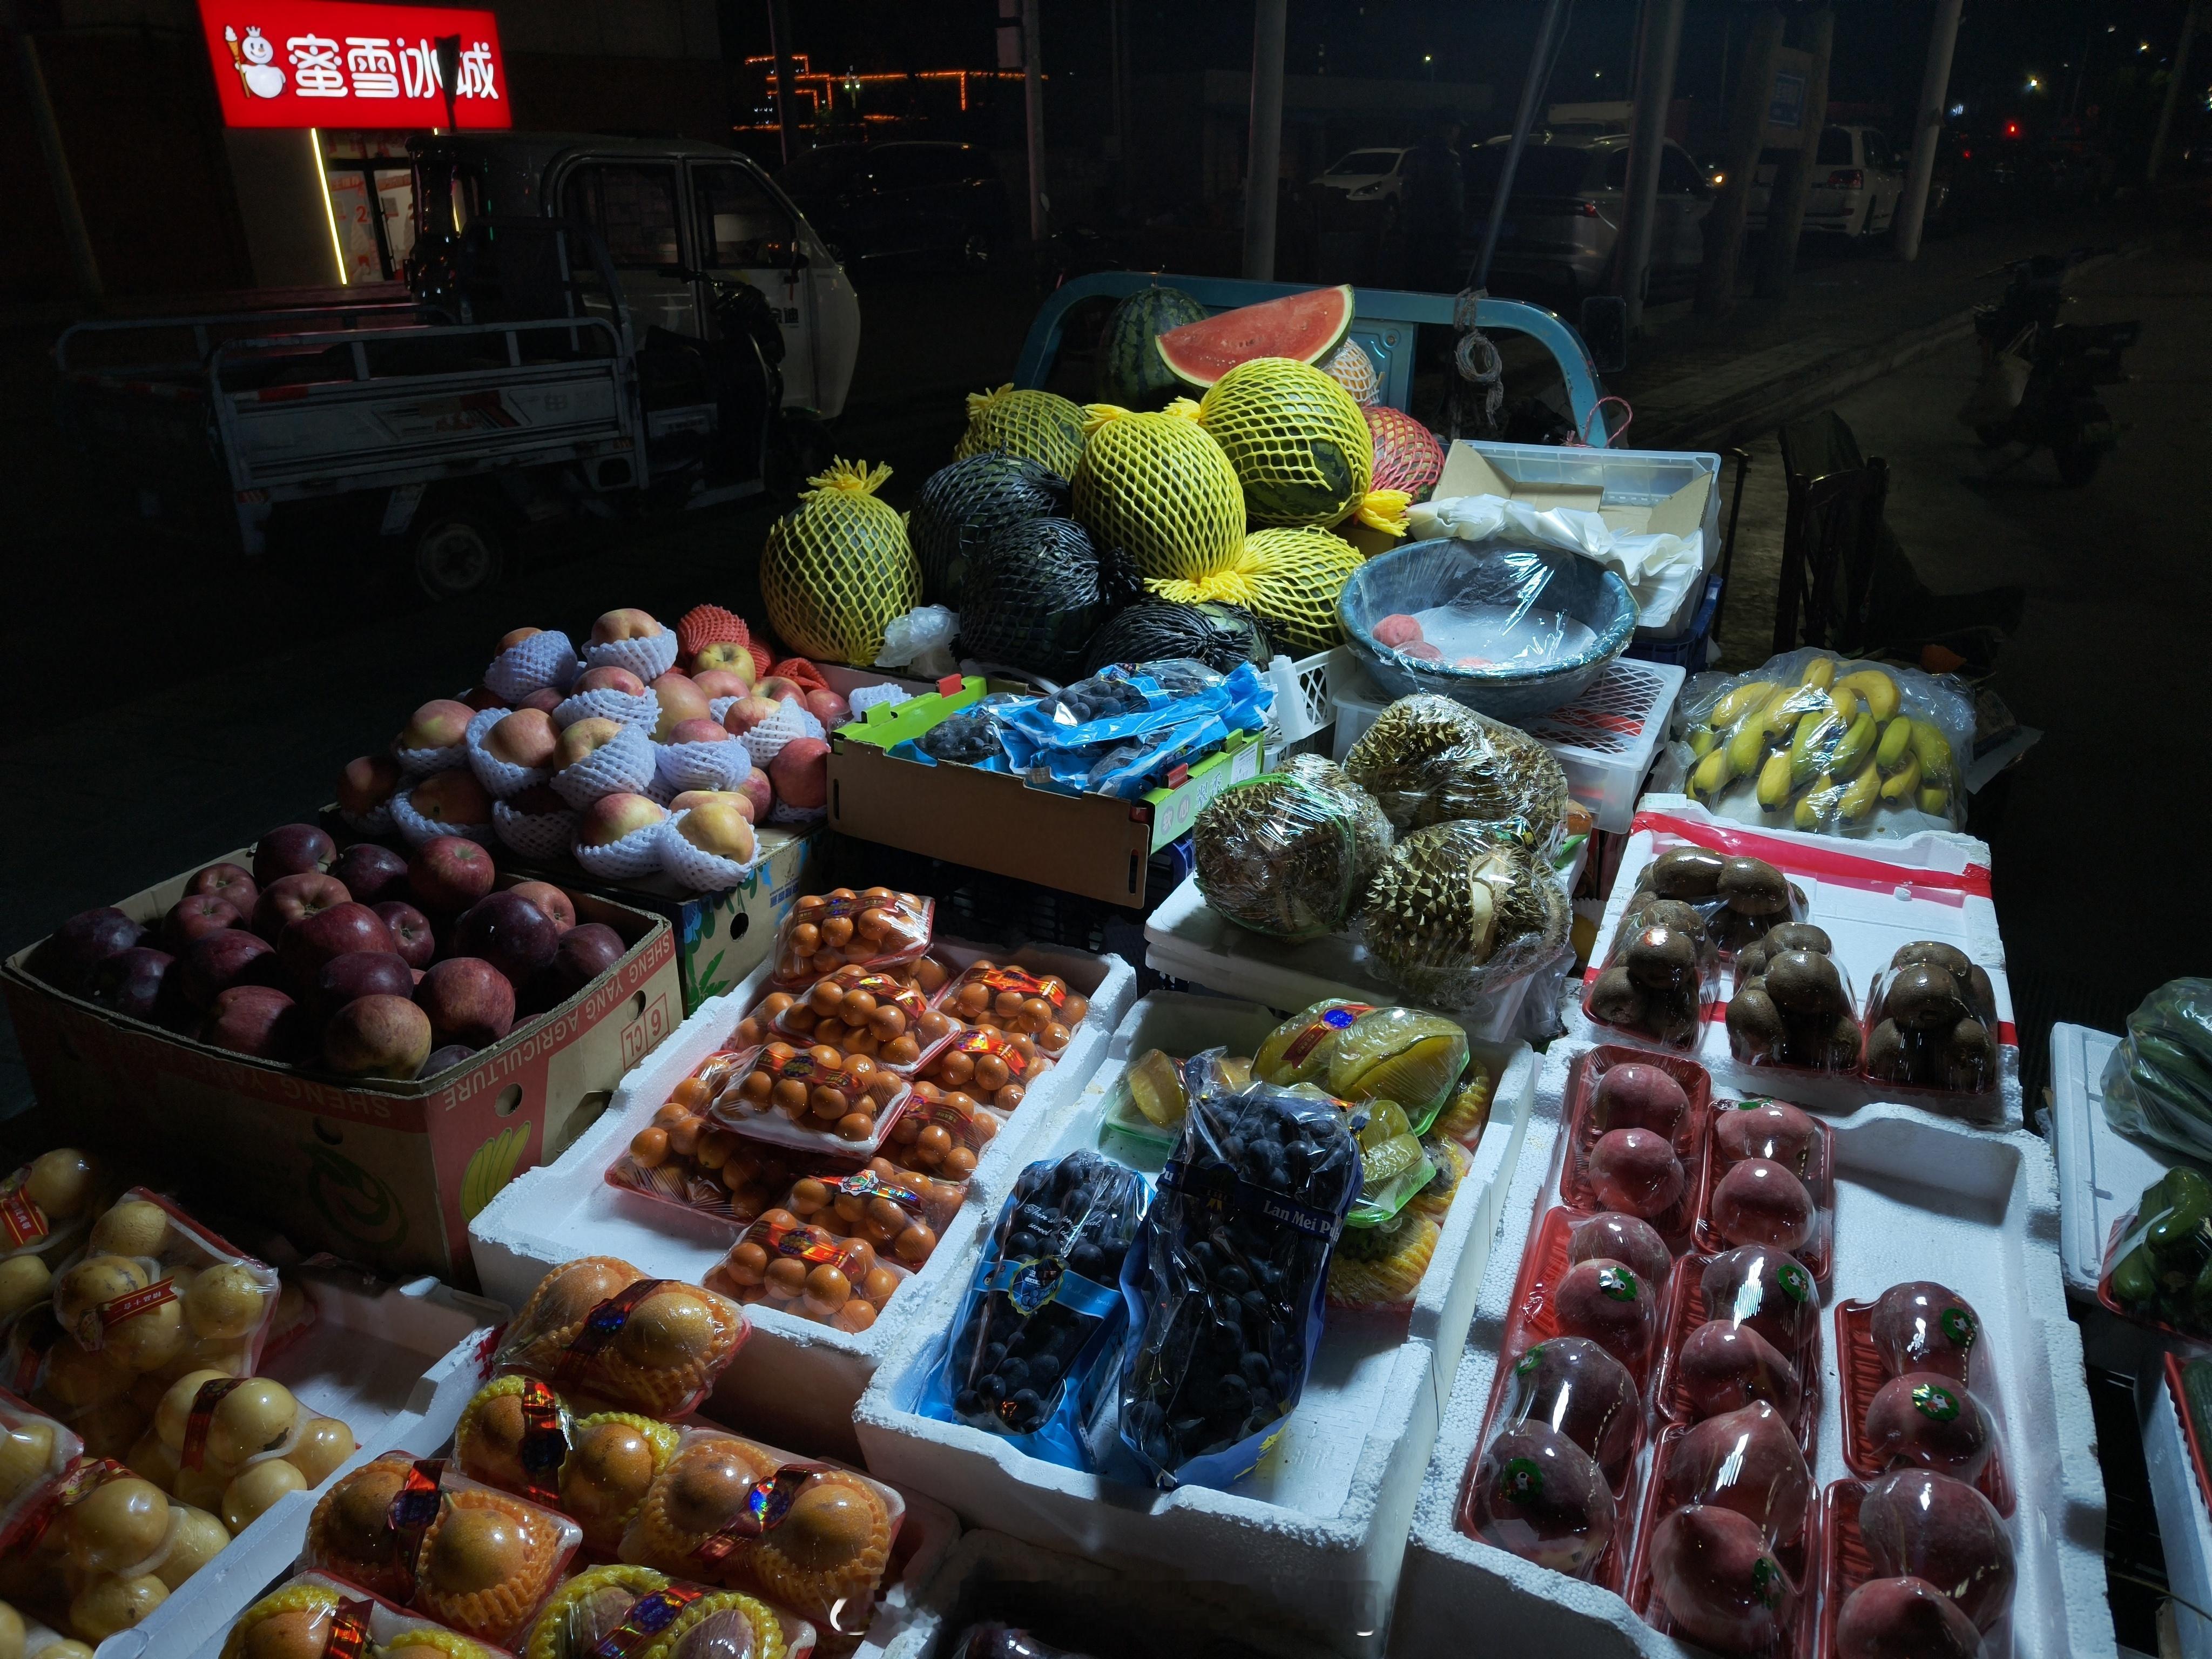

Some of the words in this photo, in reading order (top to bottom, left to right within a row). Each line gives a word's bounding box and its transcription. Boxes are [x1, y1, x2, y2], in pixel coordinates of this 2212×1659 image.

[629, 933, 670, 984] SHENG
[586, 987, 624, 1021] YANG
[650, 1009, 662, 1037] 6
[625, 1030, 644, 1058] CL
[443, 1010, 579, 1112] AGRICULTURE
[280, 1080, 392, 1118] SHENG
[1024, 1204, 1048, 1222] Thin
[1263, 1199, 1291, 1222] Lan
[1291, 1211, 1318, 1232] Mei
